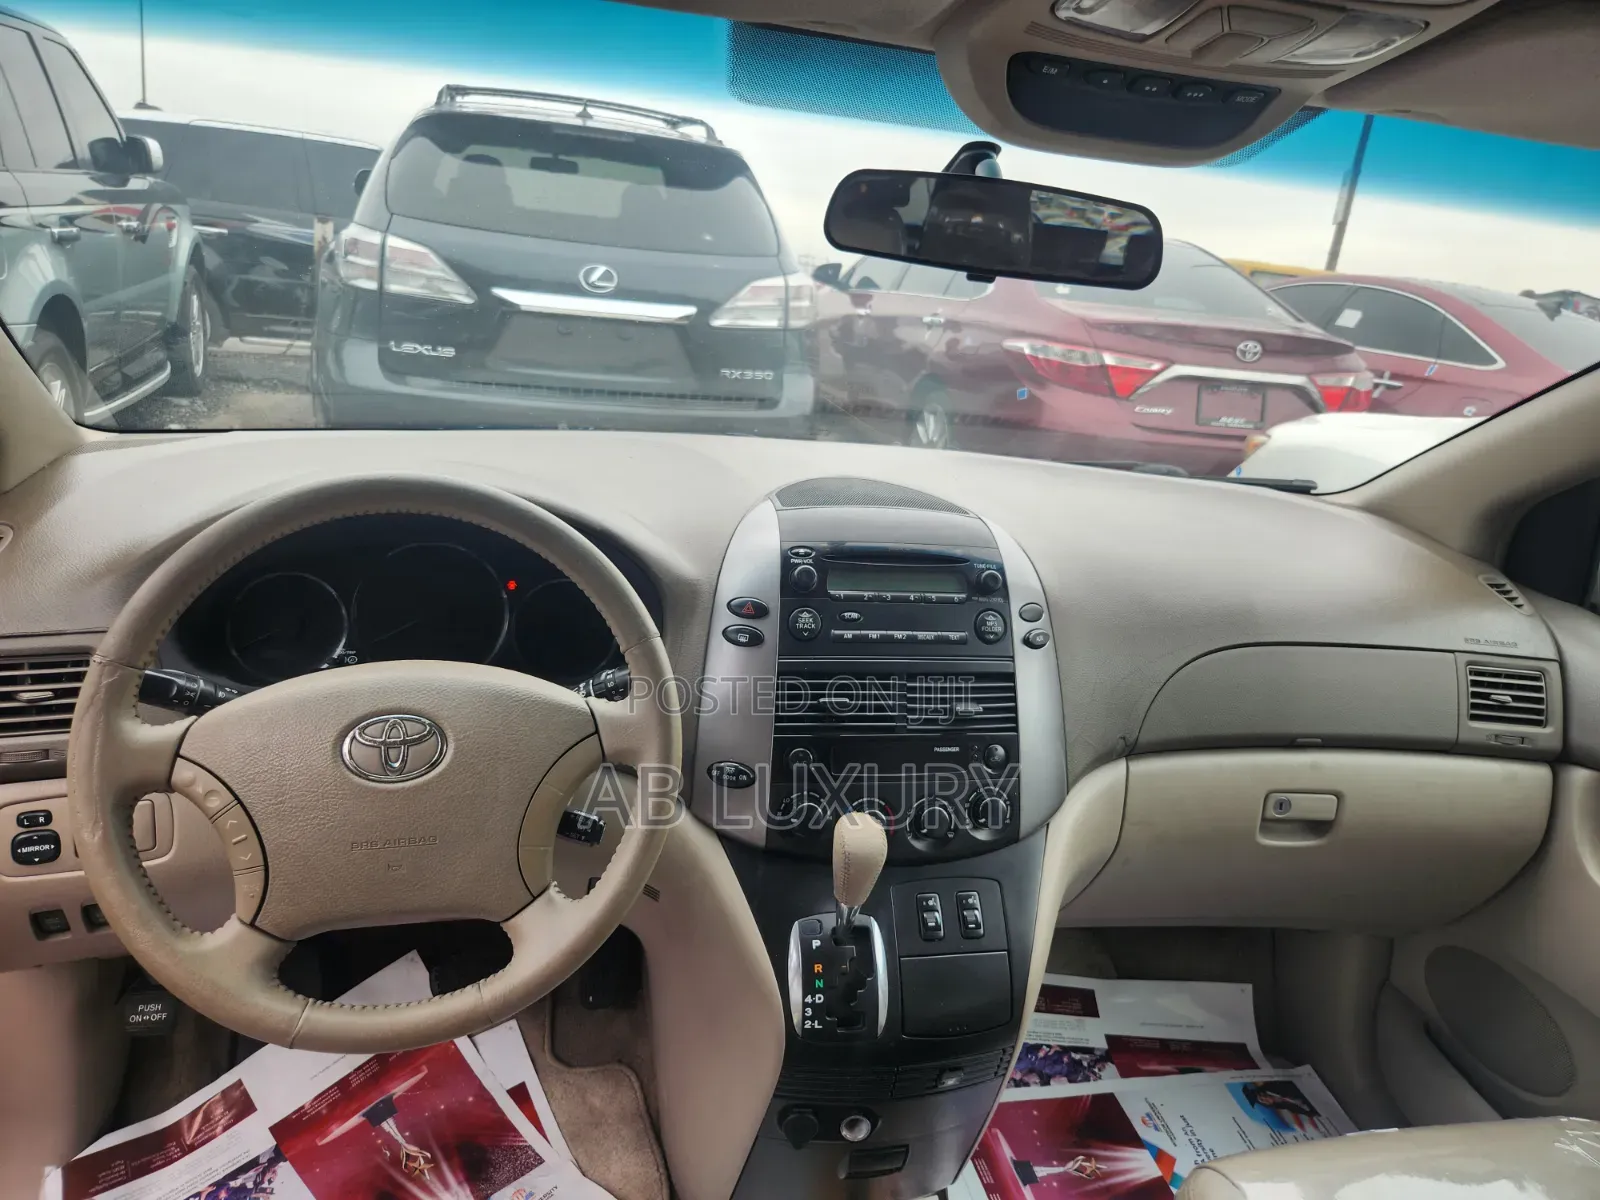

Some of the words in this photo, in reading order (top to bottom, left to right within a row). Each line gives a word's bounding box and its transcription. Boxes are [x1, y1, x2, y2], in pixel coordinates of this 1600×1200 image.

[389, 340, 456, 358] LEXUS
[844, 612, 858, 620] SCAN
[21, 844, 51, 853] MIRROR
[812, 939, 821, 950] P
[814, 963, 823, 973] R
[815, 979, 824, 988] N
[137, 1003, 162, 1013] PUSH
[804, 1008, 813, 1017] 3
[129, 1014, 142, 1023] ON
[150, 1012, 168, 1022] OFF
